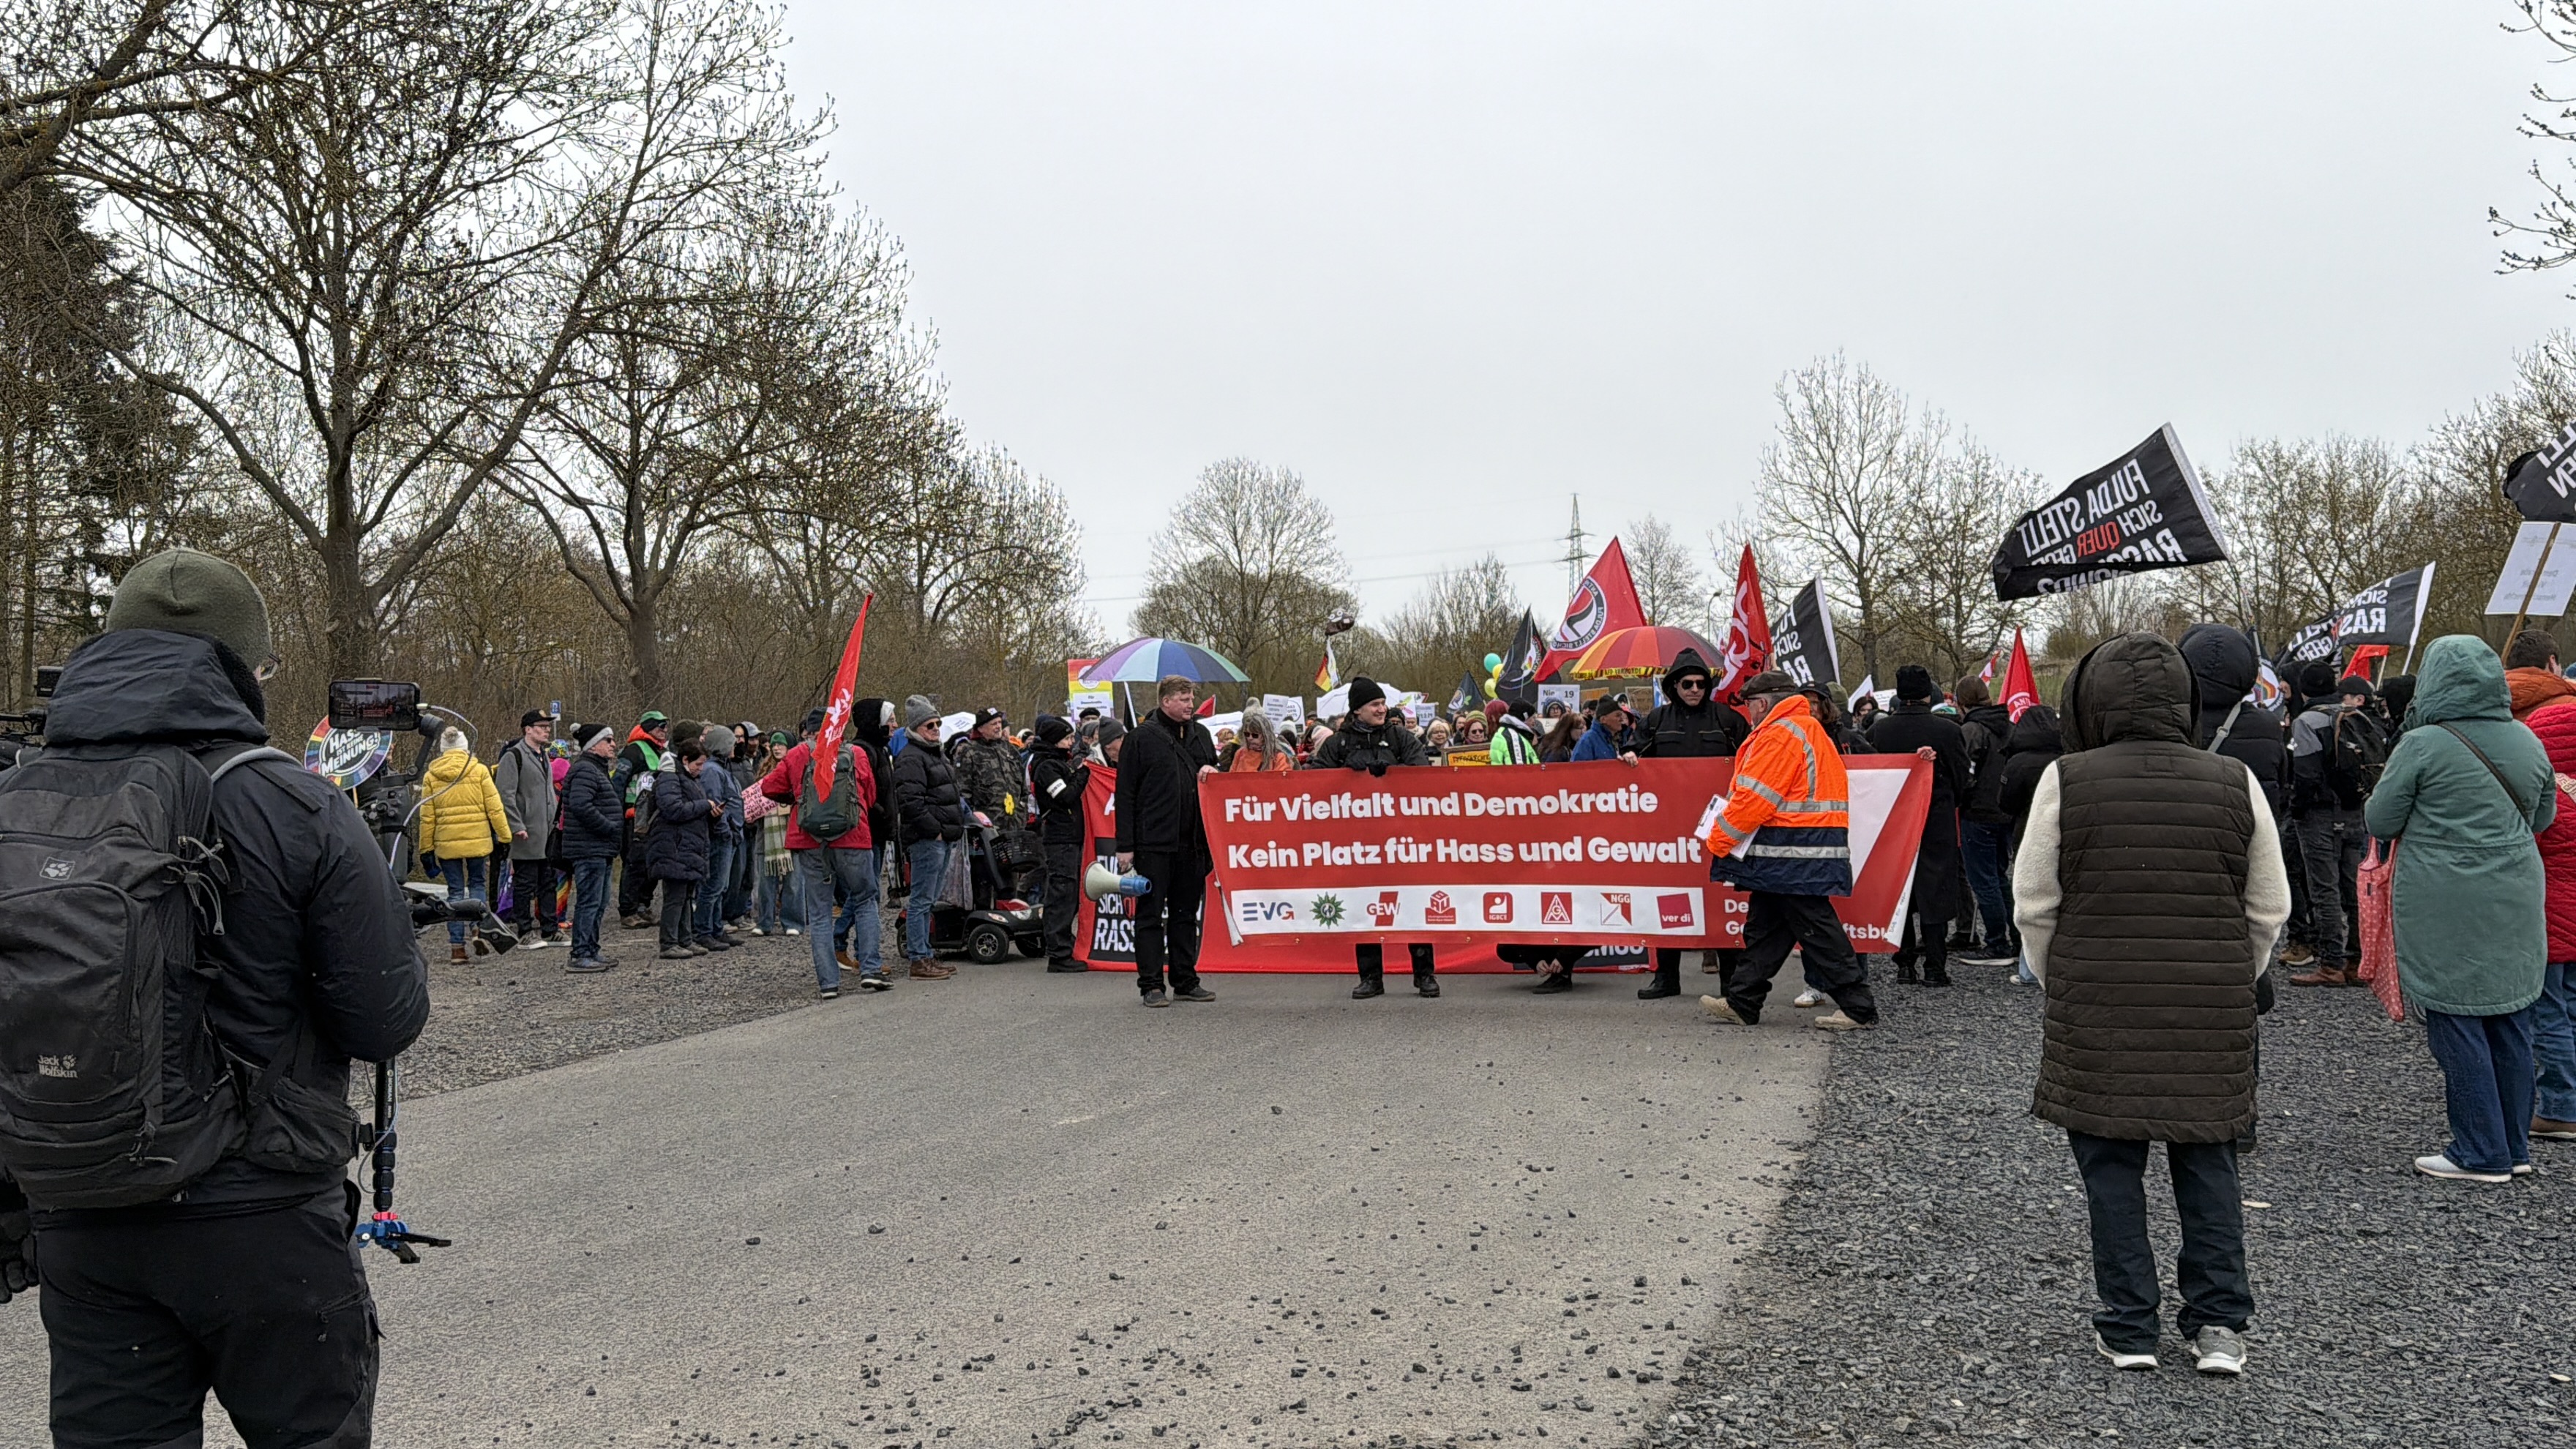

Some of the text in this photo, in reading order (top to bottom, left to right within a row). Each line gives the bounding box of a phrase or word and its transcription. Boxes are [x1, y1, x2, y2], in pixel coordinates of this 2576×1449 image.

[322, 732, 378, 777] MEINUNG!
[1225, 783, 1658, 823] Für Vielfalt und Demokratie
[1228, 836, 1702, 869] Kein Platz für Hass und Gewalt
[1098, 894, 1124, 915] SICH
[1611, 894, 1630, 904] NGG
[1243, 902, 1295, 922] EVG
[1366, 903, 1401, 916] GEW
[38, 1055, 59, 1066] Jack
[39, 1064, 78, 1079] Wolfskin
